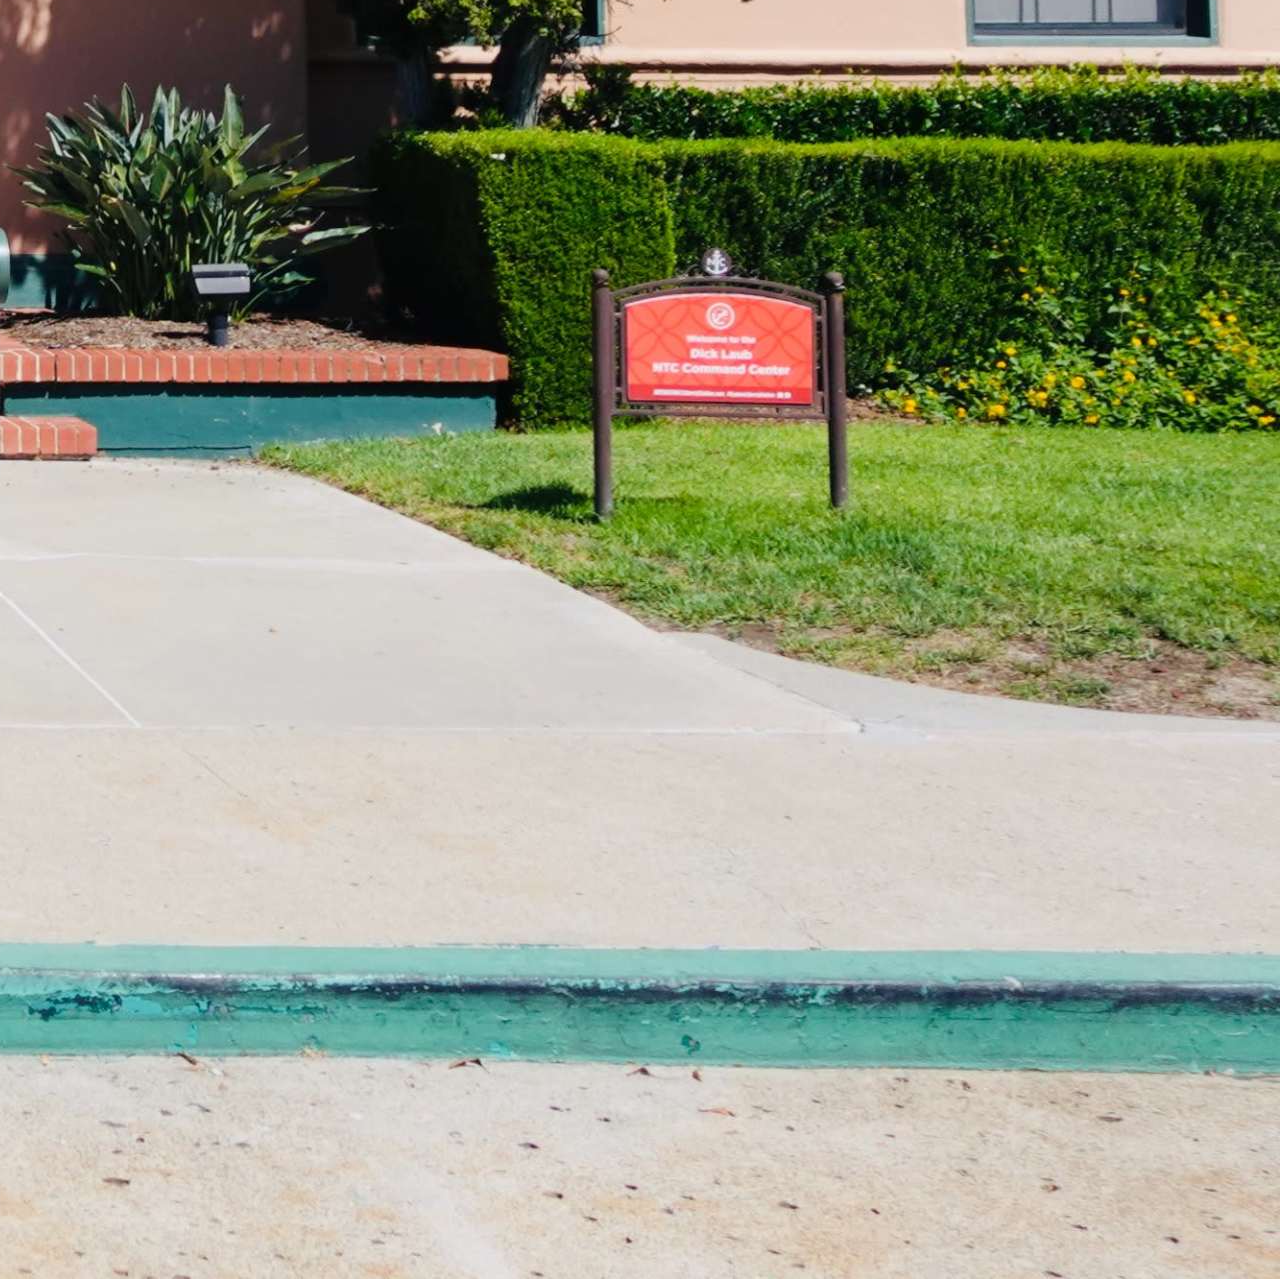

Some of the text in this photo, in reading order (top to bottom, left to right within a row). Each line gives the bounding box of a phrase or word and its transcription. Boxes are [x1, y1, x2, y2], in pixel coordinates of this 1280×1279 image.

[690, 348, 752, 360] Dick Laub
[653, 362, 791, 376] NTC Command Center
